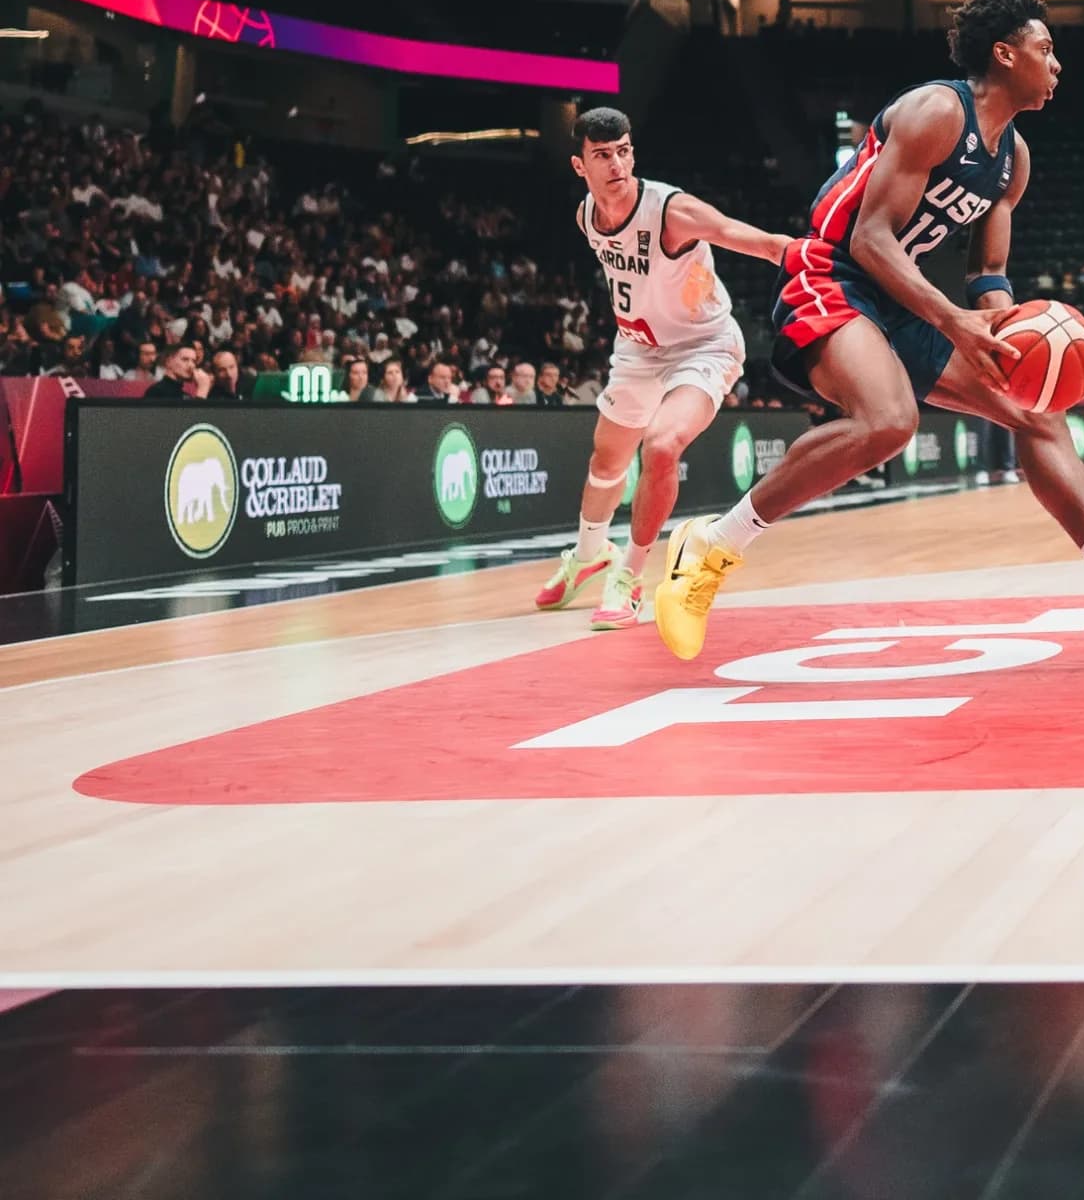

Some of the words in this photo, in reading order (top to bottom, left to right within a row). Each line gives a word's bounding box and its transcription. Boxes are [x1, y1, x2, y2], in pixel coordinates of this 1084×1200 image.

[902, 211, 948, 265] 12
[600, 248, 650, 276] ORDAN
[241, 456, 328, 490] COLLAUD
[245, 482, 342, 518] &CRIBLET
[266, 520, 286, 538] PUB
